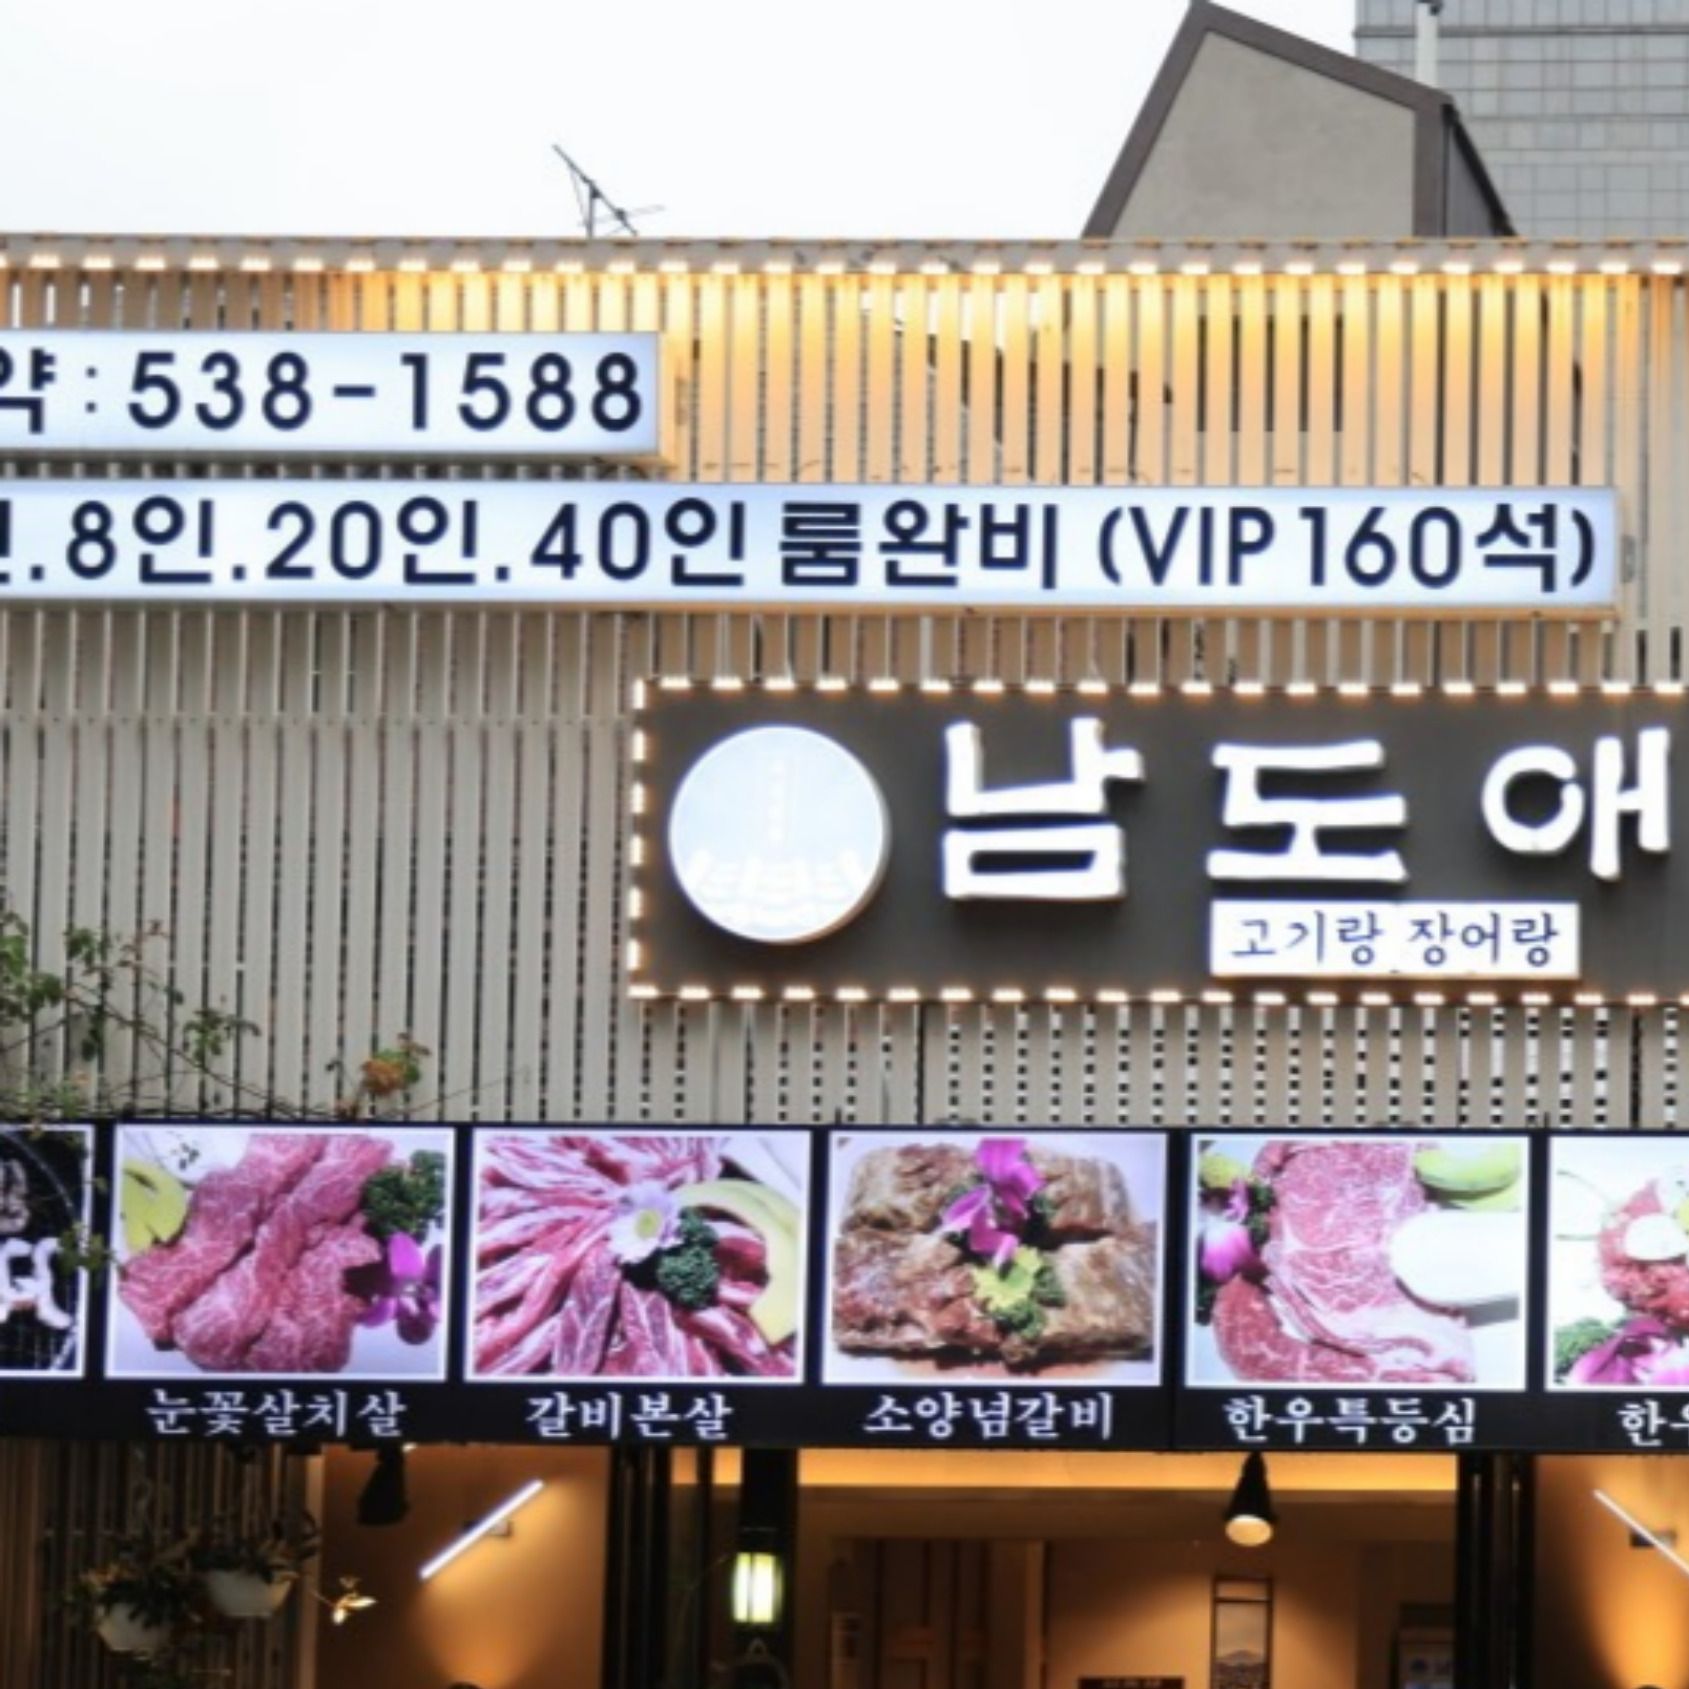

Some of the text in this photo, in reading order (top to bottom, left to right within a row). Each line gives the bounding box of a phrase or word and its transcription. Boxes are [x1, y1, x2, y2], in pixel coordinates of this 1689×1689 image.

[0, 495, 746, 586] .8인.20인.40인
[779, 500, 1058, 590] 룸완비
[1229, 910, 1560, 968] 고기랑 장어랑
[146, 1389, 406, 1437] 눈꽃살치살
[524, 1390, 734, 1440] 갈비본살
[862, 1391, 1114, 1440] 소양념갈비
[1221, 1395, 1477, 1444] 한우특등심
